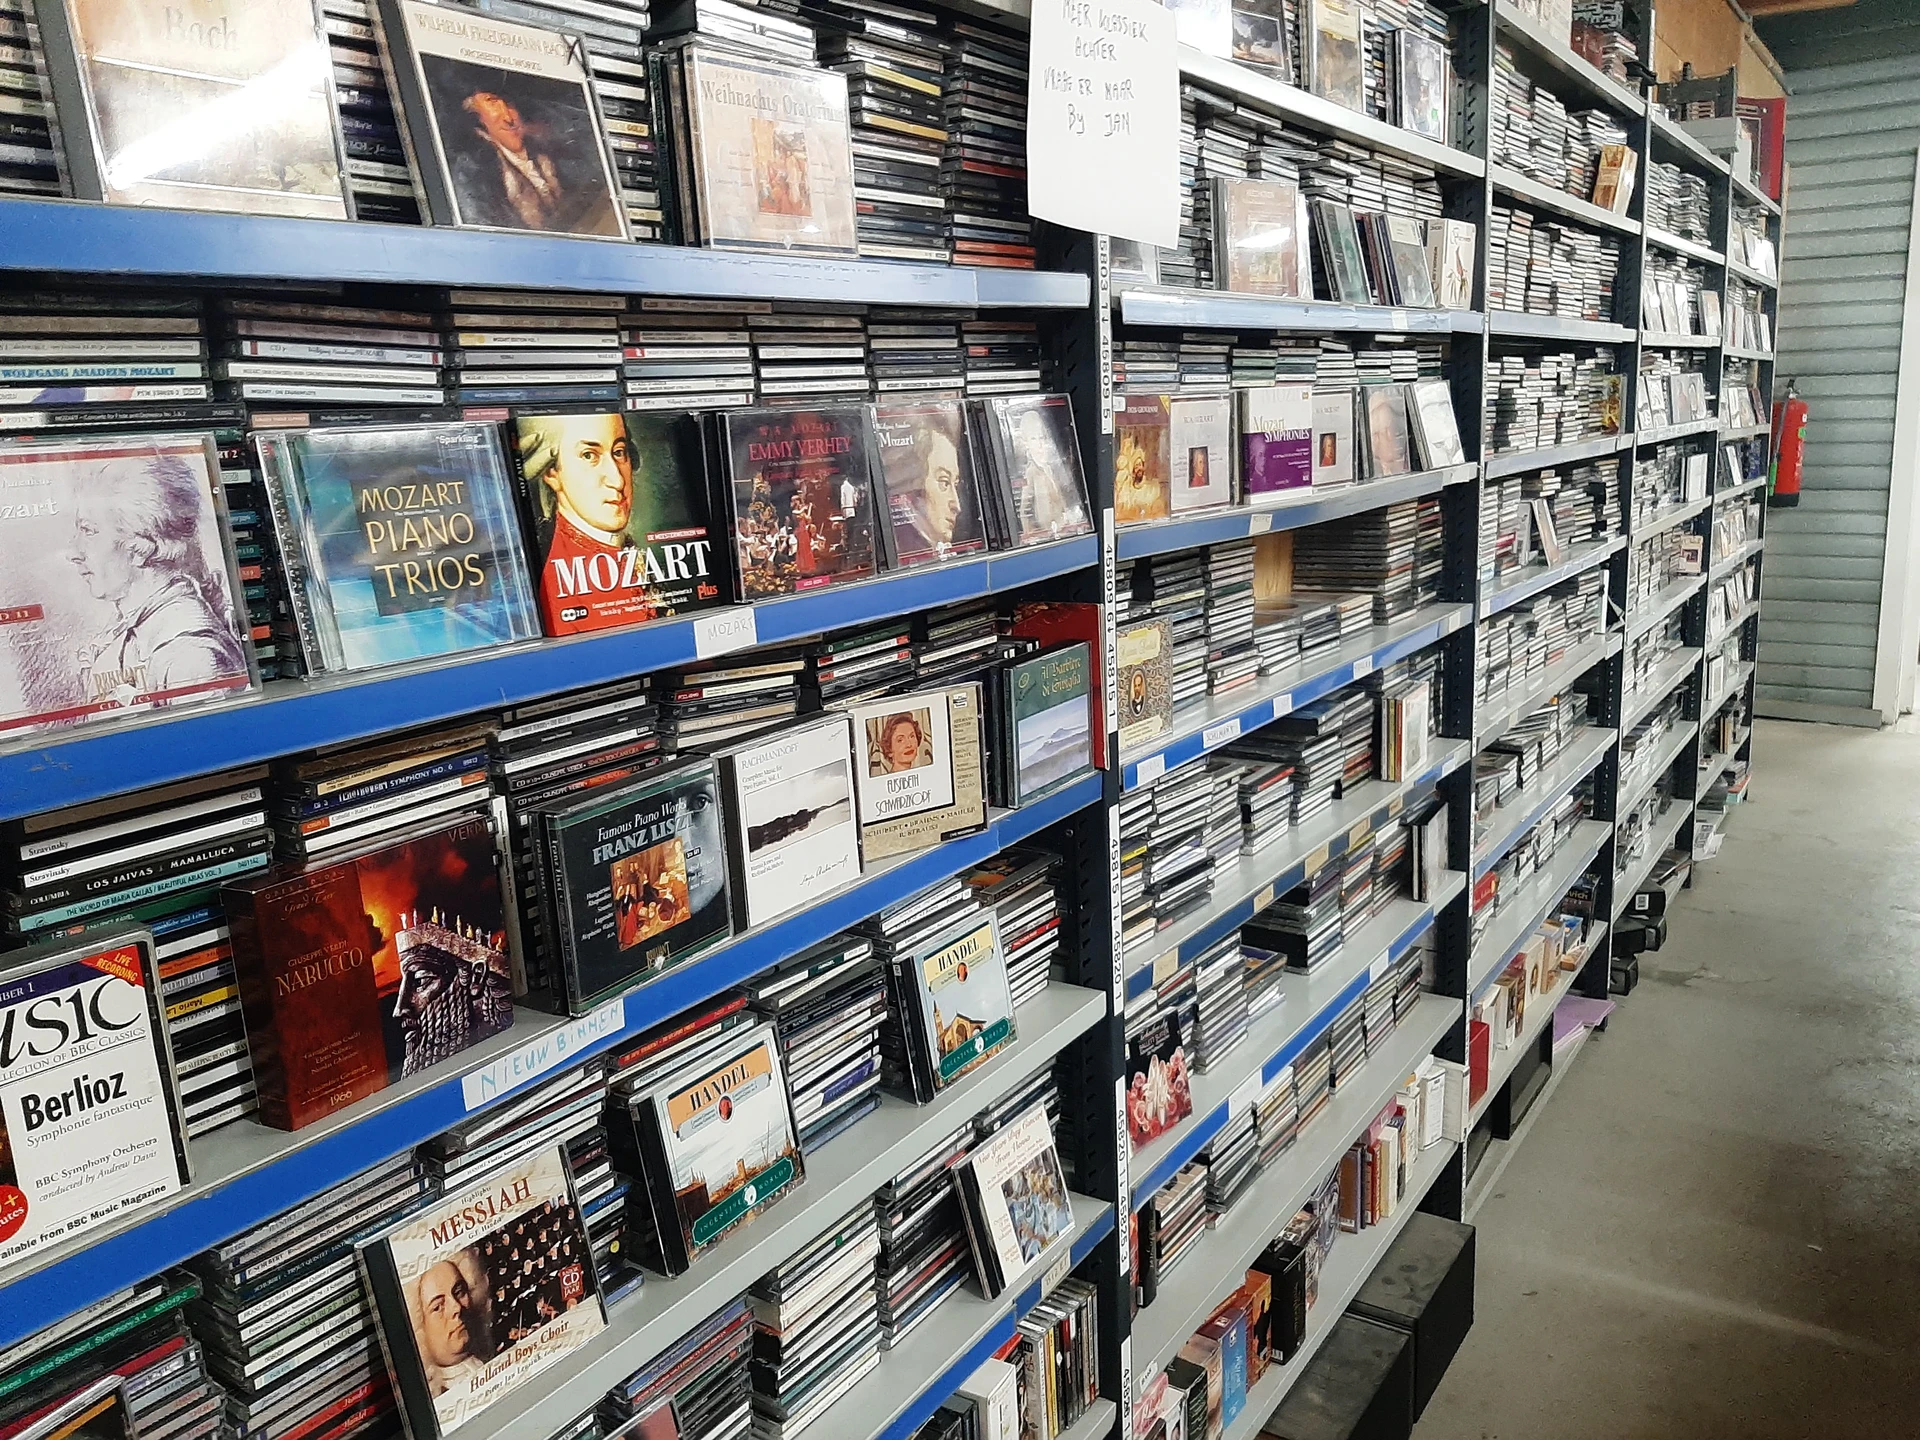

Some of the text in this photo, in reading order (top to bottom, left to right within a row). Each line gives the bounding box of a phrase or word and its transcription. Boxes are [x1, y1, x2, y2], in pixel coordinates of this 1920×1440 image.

[164, 7, 239, 52] Bach
[1075, 36, 1117, 61] ACHTER
[700, 79, 779, 112] Weihnachts
[1104, 112, 1131, 137] JAN
[1, 366, 176, 378] WOLFGANG AMADEUS MOZART
[878, 432, 914, 448] Mozart
[1253, 416, 1285, 432] Mozart
[1264, 429, 1310, 443] SYMPHONIES
[748, 436, 851, 461] EMMY VERHEY
[361, 481, 464, 513] MOZART
[365, 512, 475, 554] PIANO
[374, 553, 486, 598] TRIOS
[551, 540, 712, 598] MOZART
[1106, 544, 1114, 604] 45809
[708, 617, 754, 640] MOZART
[1108, 643, 1116, 701] 45815
[741, 743, 799, 770] RACHMANINOFF
[389, 770, 430, 788] SYMPHONY
[432, 766, 446, 775] NO.
[887, 773, 919, 794] ELISABETH
[875, 789, 932, 817] SCHWARZKOPF
[591, 811, 694, 866] FRANZ LISZT
[597, 801, 687, 842] Famous Piano Works
[864, 806, 976, 839] SCHUBERT BRAHMS MAHLER
[908, 824, 939, 836] STRAUSS
[28, 840, 70, 857] Stravinsky
[29, 866, 72, 883] Stravinsky
[30, 890, 70, 905] COLUMBIA
[86, 878, 110, 891] LOS
[112, 867, 154, 885] JAIVAS
[170, 846, 235, 869] MAMALLUCA
[1110, 839, 1120, 894] 45815
[66, 907, 78, 917] THE
[79, 903, 101, 915] WORLD
[111, 893, 131, 905] MARIA
[131, 886, 153, 900] CALLAS
[158, 877, 186, 893] BEAUTIFUL
[187, 873, 204, 885] ARIAS
[96, 958, 139, 982] RECORDING
[114, 952, 132, 965] LIVE
[938, 937, 980, 972] HANDEL
[1114, 930, 1122, 984] 45820
[275, 946, 364, 998] NABUCCO
[53, 1053, 67, 1064] OF
[70, 1040, 97, 1057] BBC
[19, 1071, 128, 1133] Berlioz
[688, 1063, 751, 1113] HANDEL
[26, 1095, 153, 1149] Symphonie fantastique
[1118, 1109, 1126, 1162] 45820
[35, 1137, 158, 1190] BBC Symphony Orchestra
[38, 1150, 158, 1204] conducted by Andrew Davis
[460, 1185, 492, 1205] Highlights
[39, 1225, 65, 1244] from
[90, 1203, 119, 1223] Music
[120, 1183, 167, 1208] Magazine
[429, 1177, 533, 1251] MESSIAH
[699, 1198, 743, 1234] INCENTIVE
[562, 1273, 580, 1286] CD
[564, 1285, 580, 1297] JAAR
[29, 1321, 134, 1378] Franz Schubert Symphony
[322, 1326, 356, 1348] HANDEL
[470, 1354, 512, 1393] Holland
[515, 1342, 538, 1363] Boys
[540, 1320, 570, 1344] Choir
